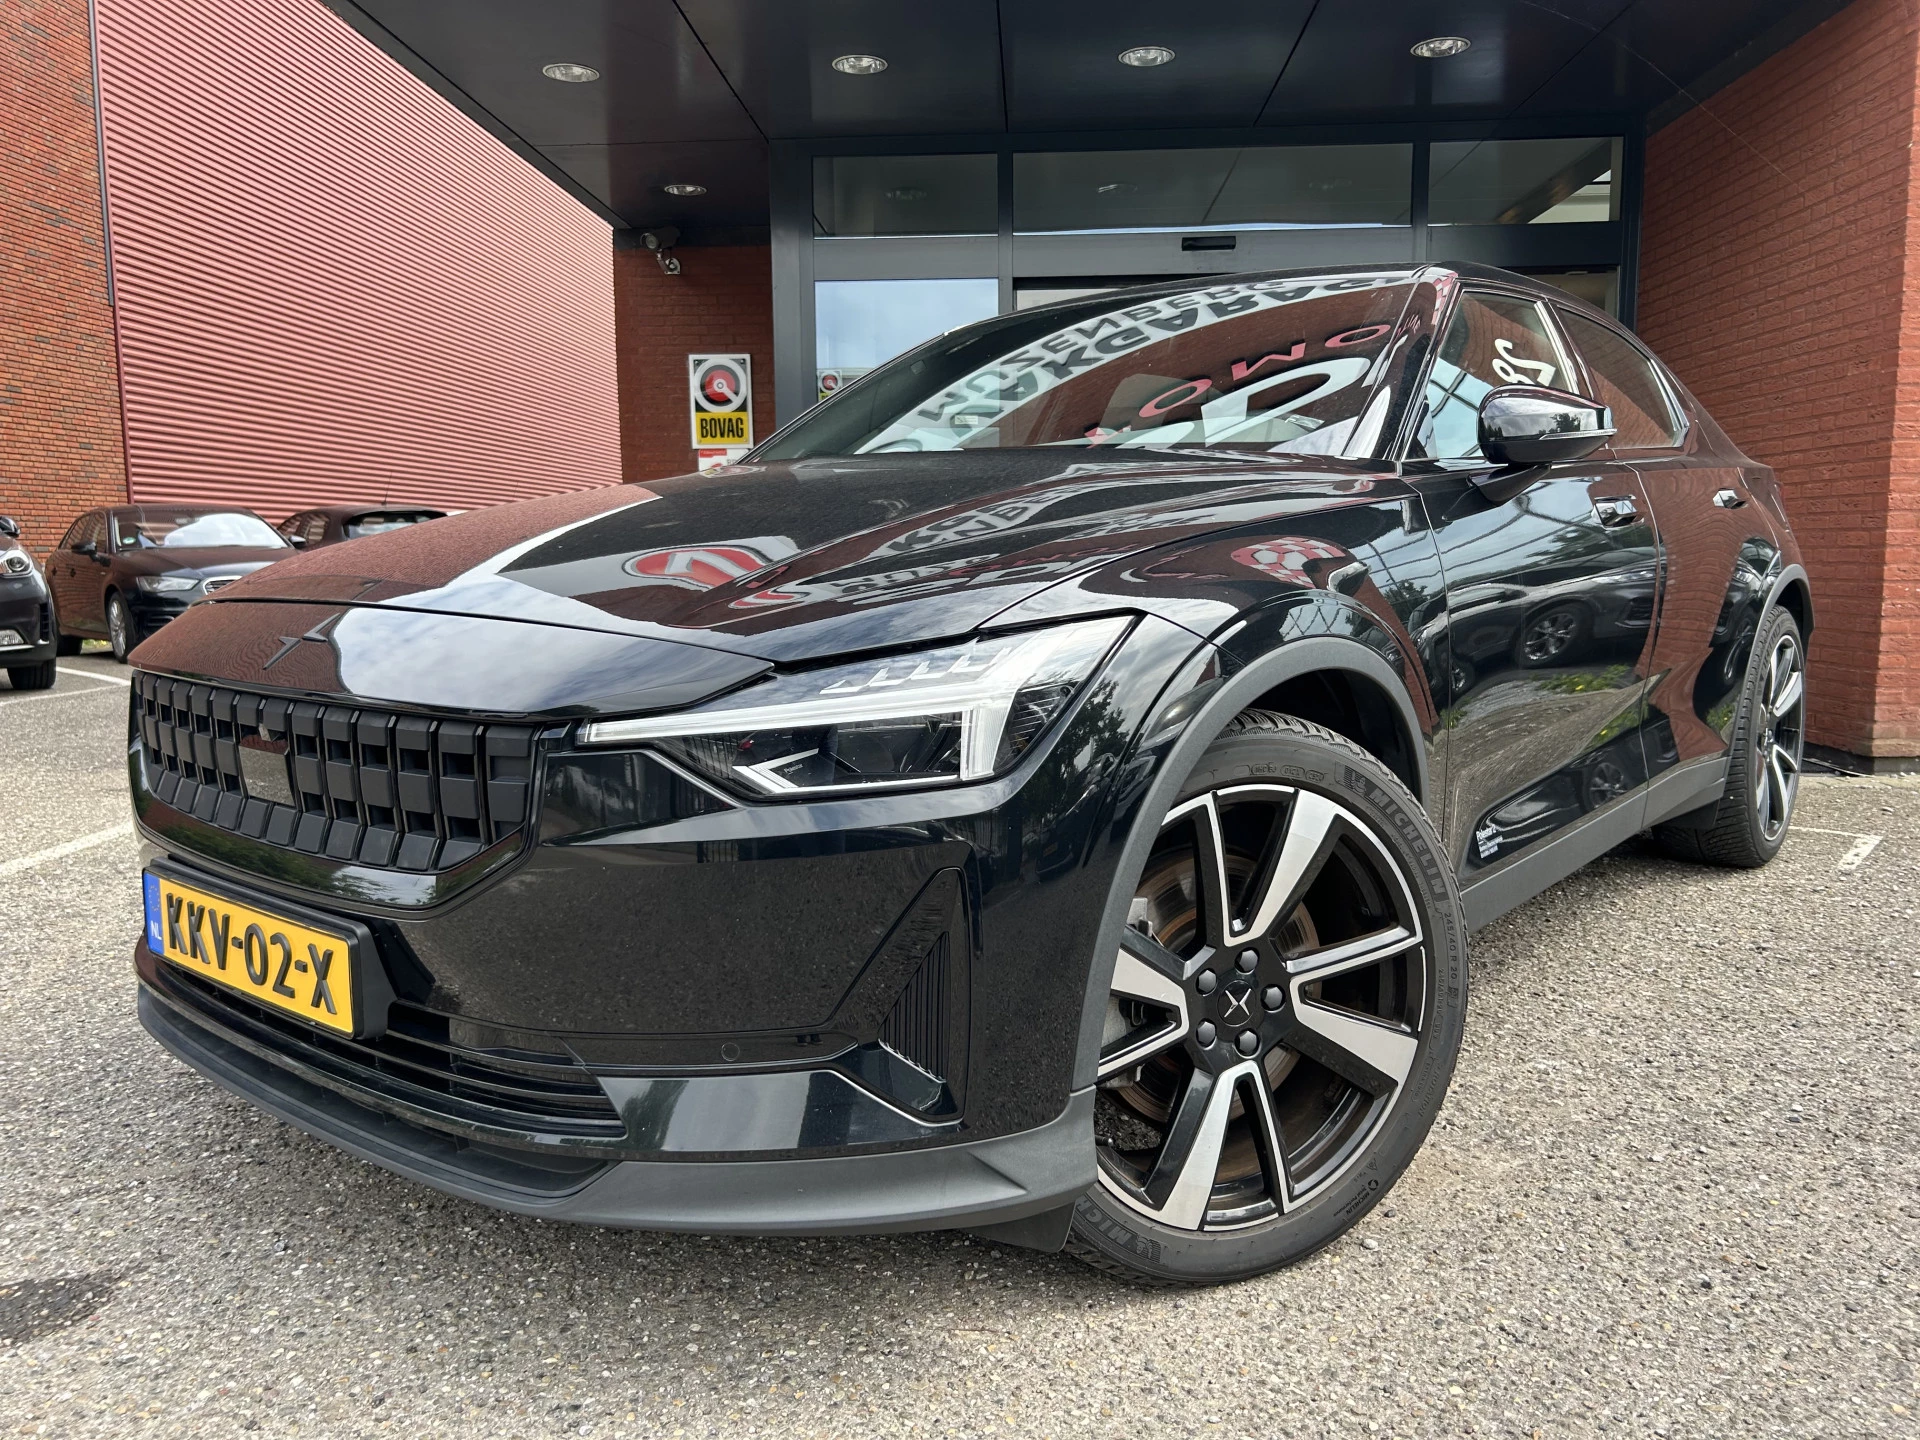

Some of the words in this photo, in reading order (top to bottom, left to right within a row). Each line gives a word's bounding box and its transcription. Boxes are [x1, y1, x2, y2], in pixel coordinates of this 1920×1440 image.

[700, 417, 744, 438] BOVAG
[1368, 788, 1445, 894] MICHELIN
[150, 920, 162, 940] NL
[1444, 913, 1456, 951] 245/40
[1450, 966, 1457, 980] 20
[166, 893, 337, 1015] KKV-02-X
[1346, 1191, 1370, 1215] MICHELIN
